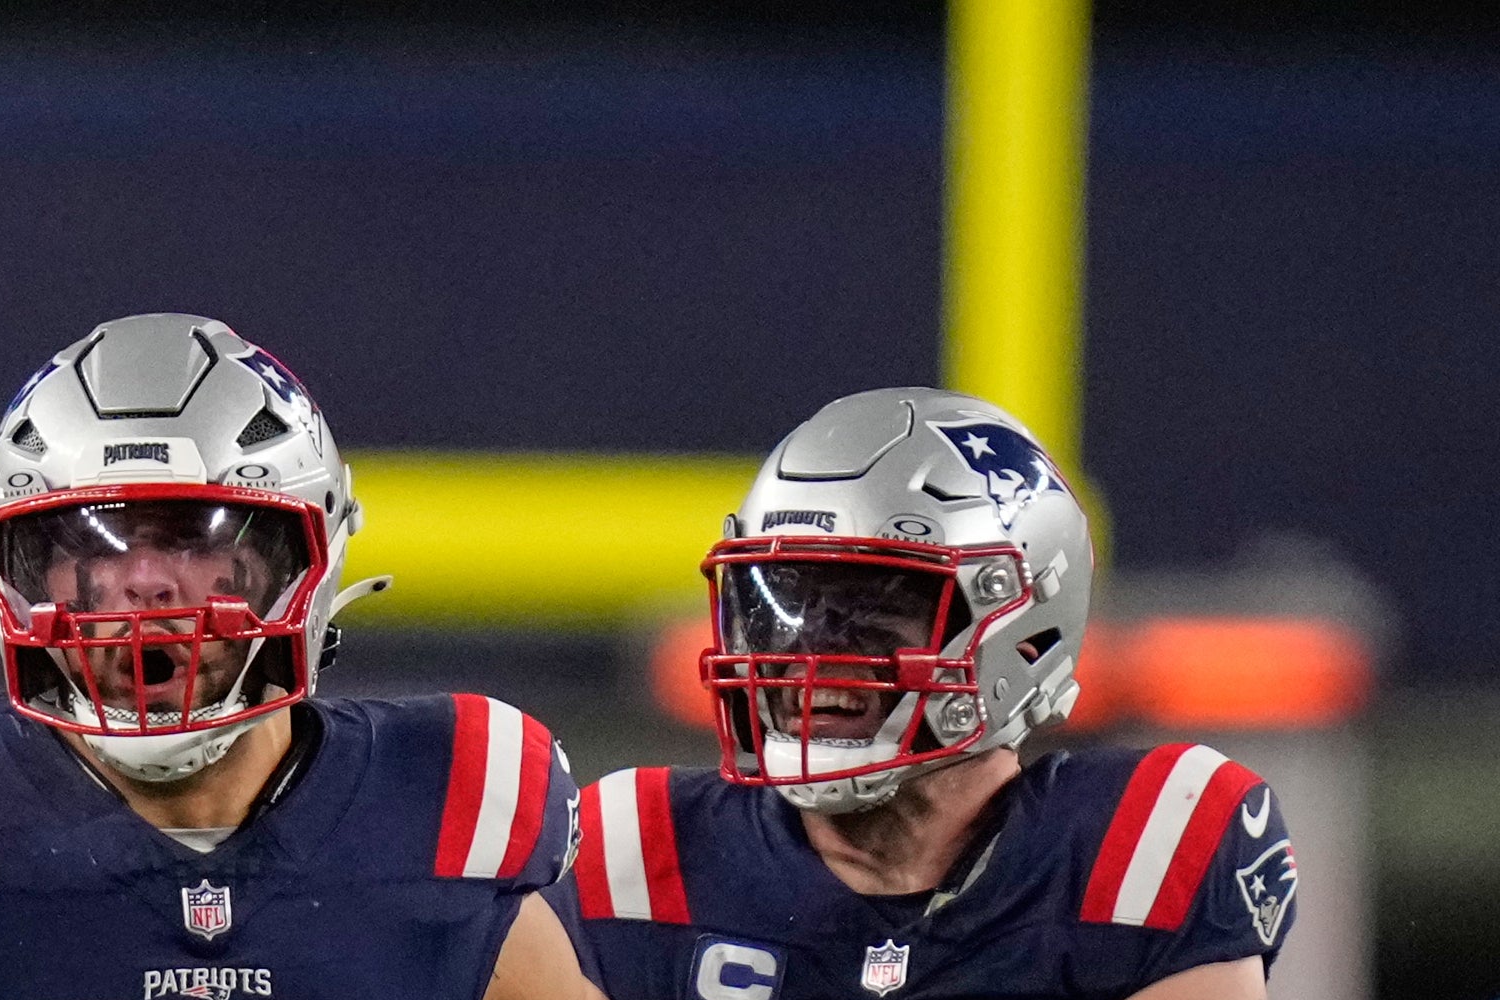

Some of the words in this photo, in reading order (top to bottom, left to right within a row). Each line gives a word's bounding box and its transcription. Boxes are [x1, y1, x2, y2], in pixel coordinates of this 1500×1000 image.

[104, 442, 170, 467] PATRIOTS
[760, 509, 837, 533] PATRIOTS
[192, 906, 224, 929] NFL
[143, 966, 273, 1000] PATRIOTS
[870, 964, 899, 986] NFL
